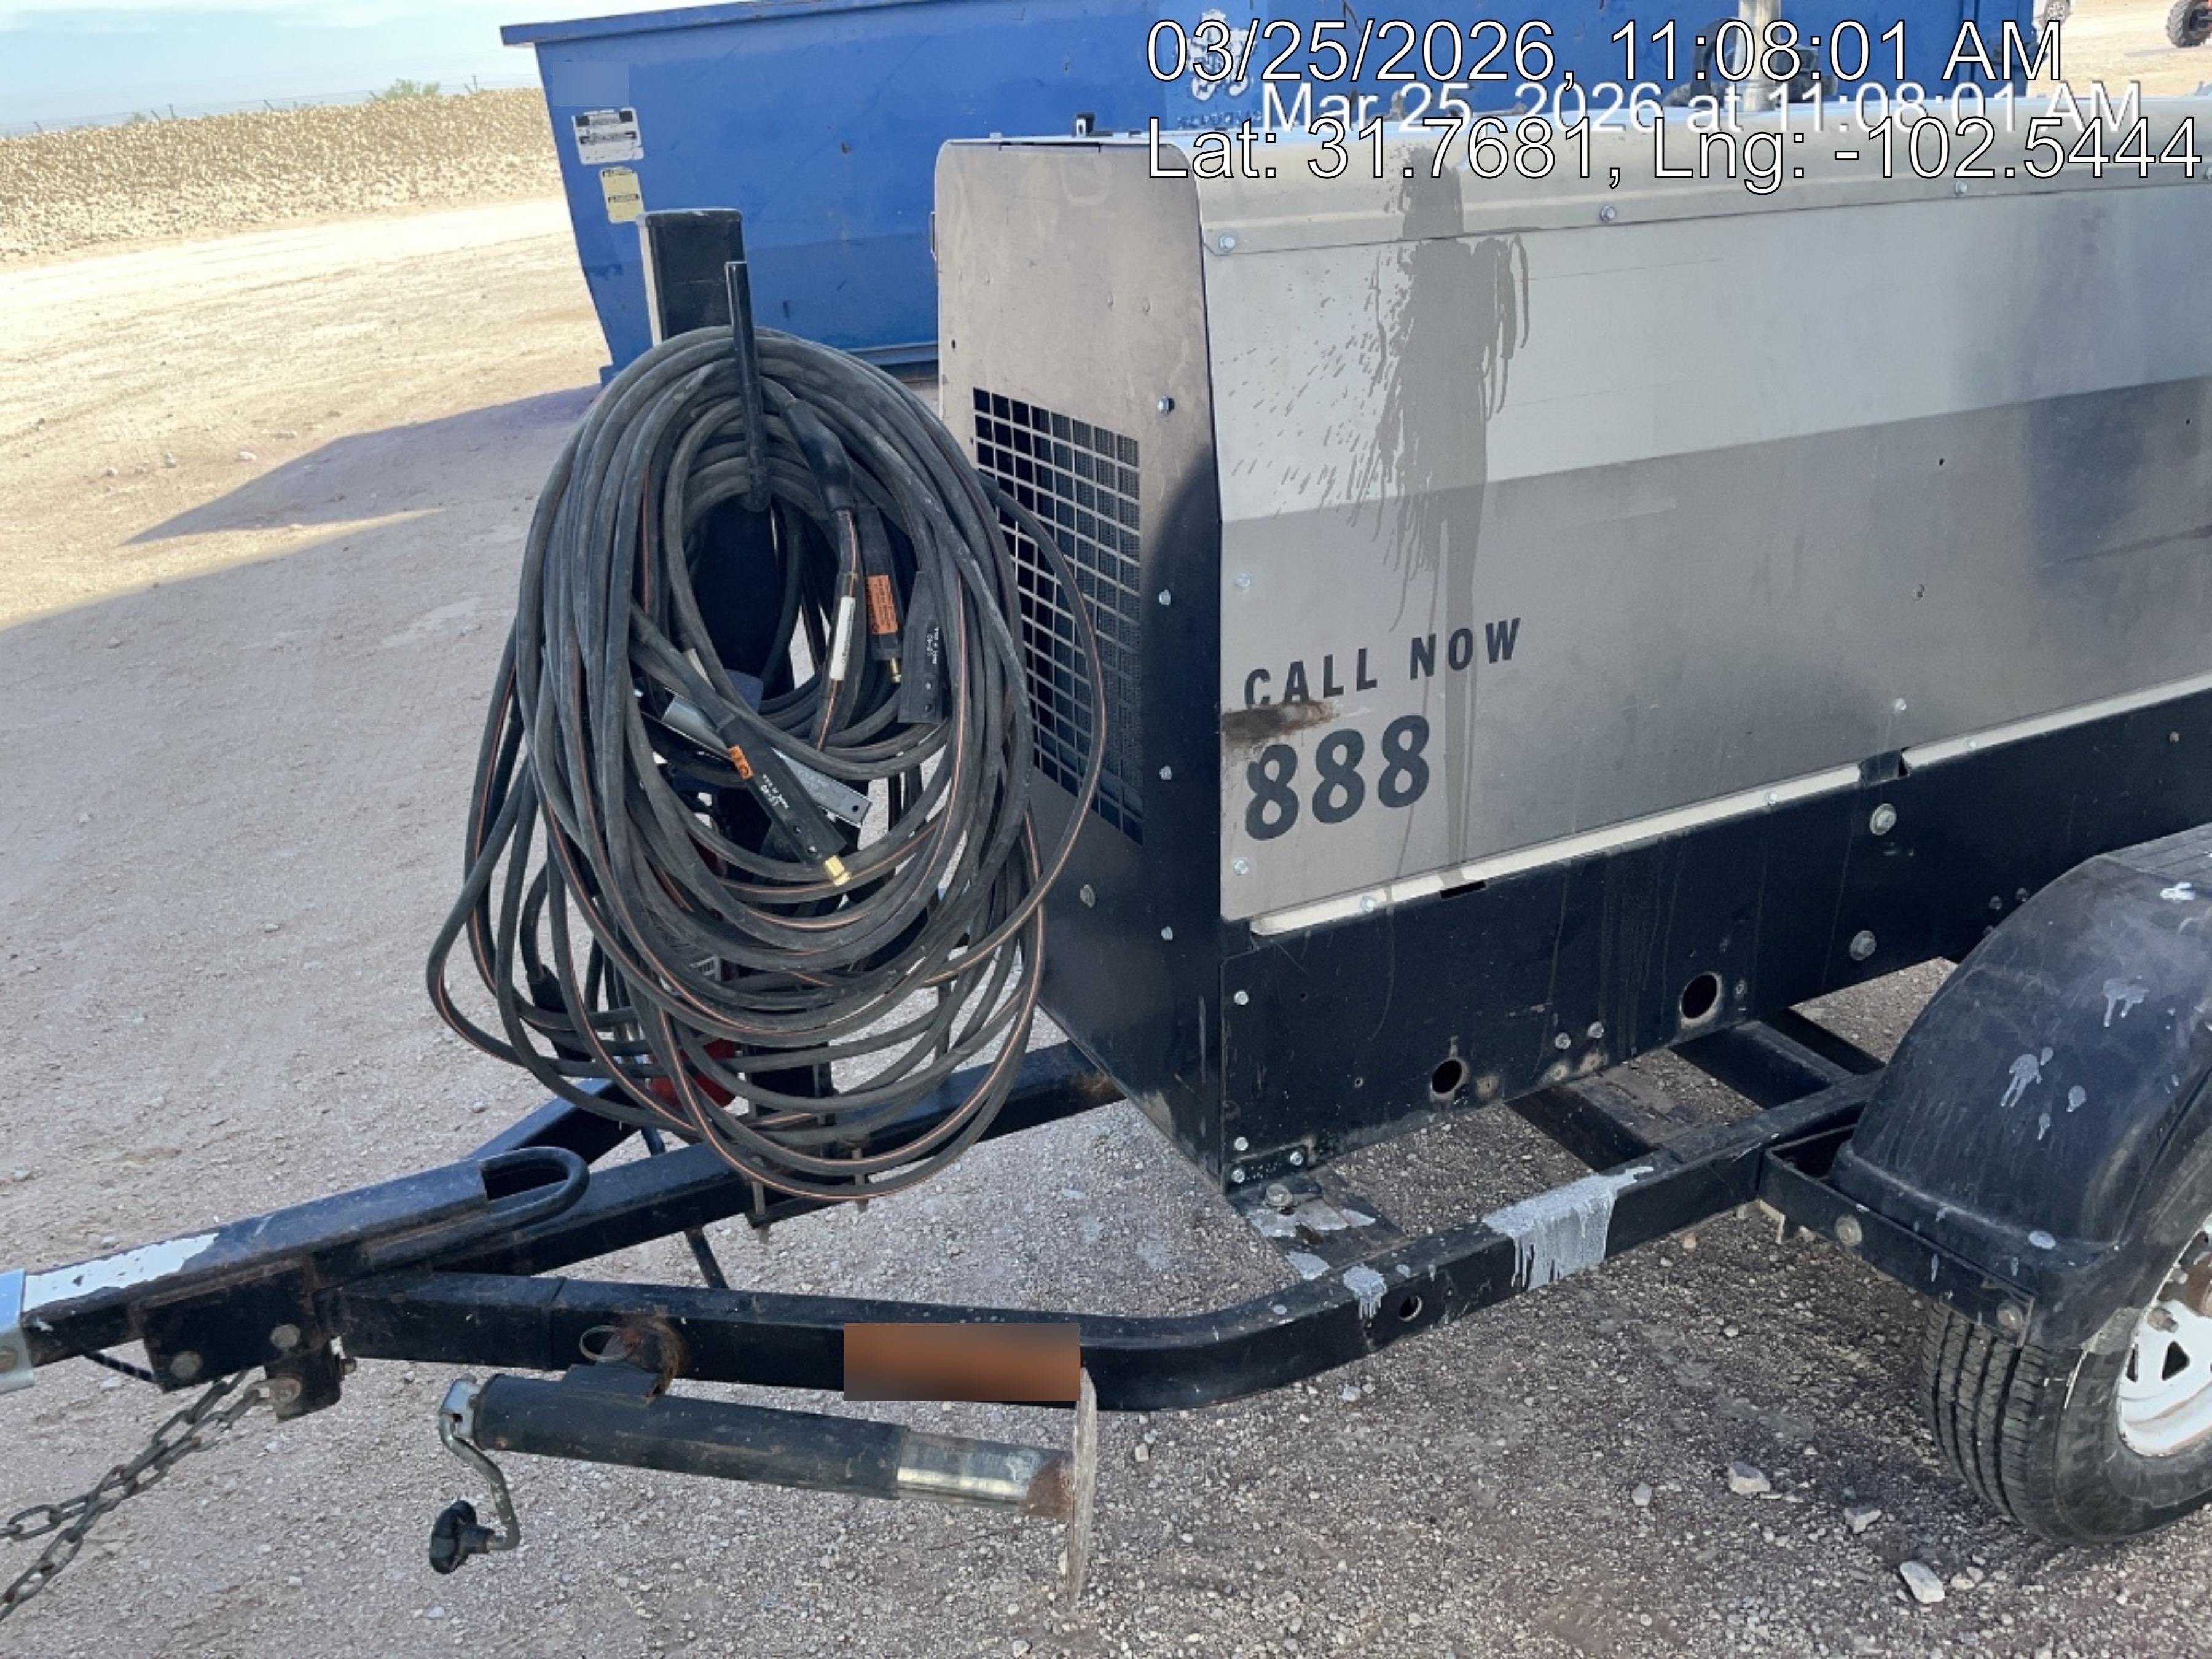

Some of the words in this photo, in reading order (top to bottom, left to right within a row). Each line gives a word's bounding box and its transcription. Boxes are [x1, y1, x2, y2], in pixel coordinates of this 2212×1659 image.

[1244, 648, 1378, 708] CALL
[1410, 617, 1521, 681] NOW
[1245, 714, 1430, 841] 888
